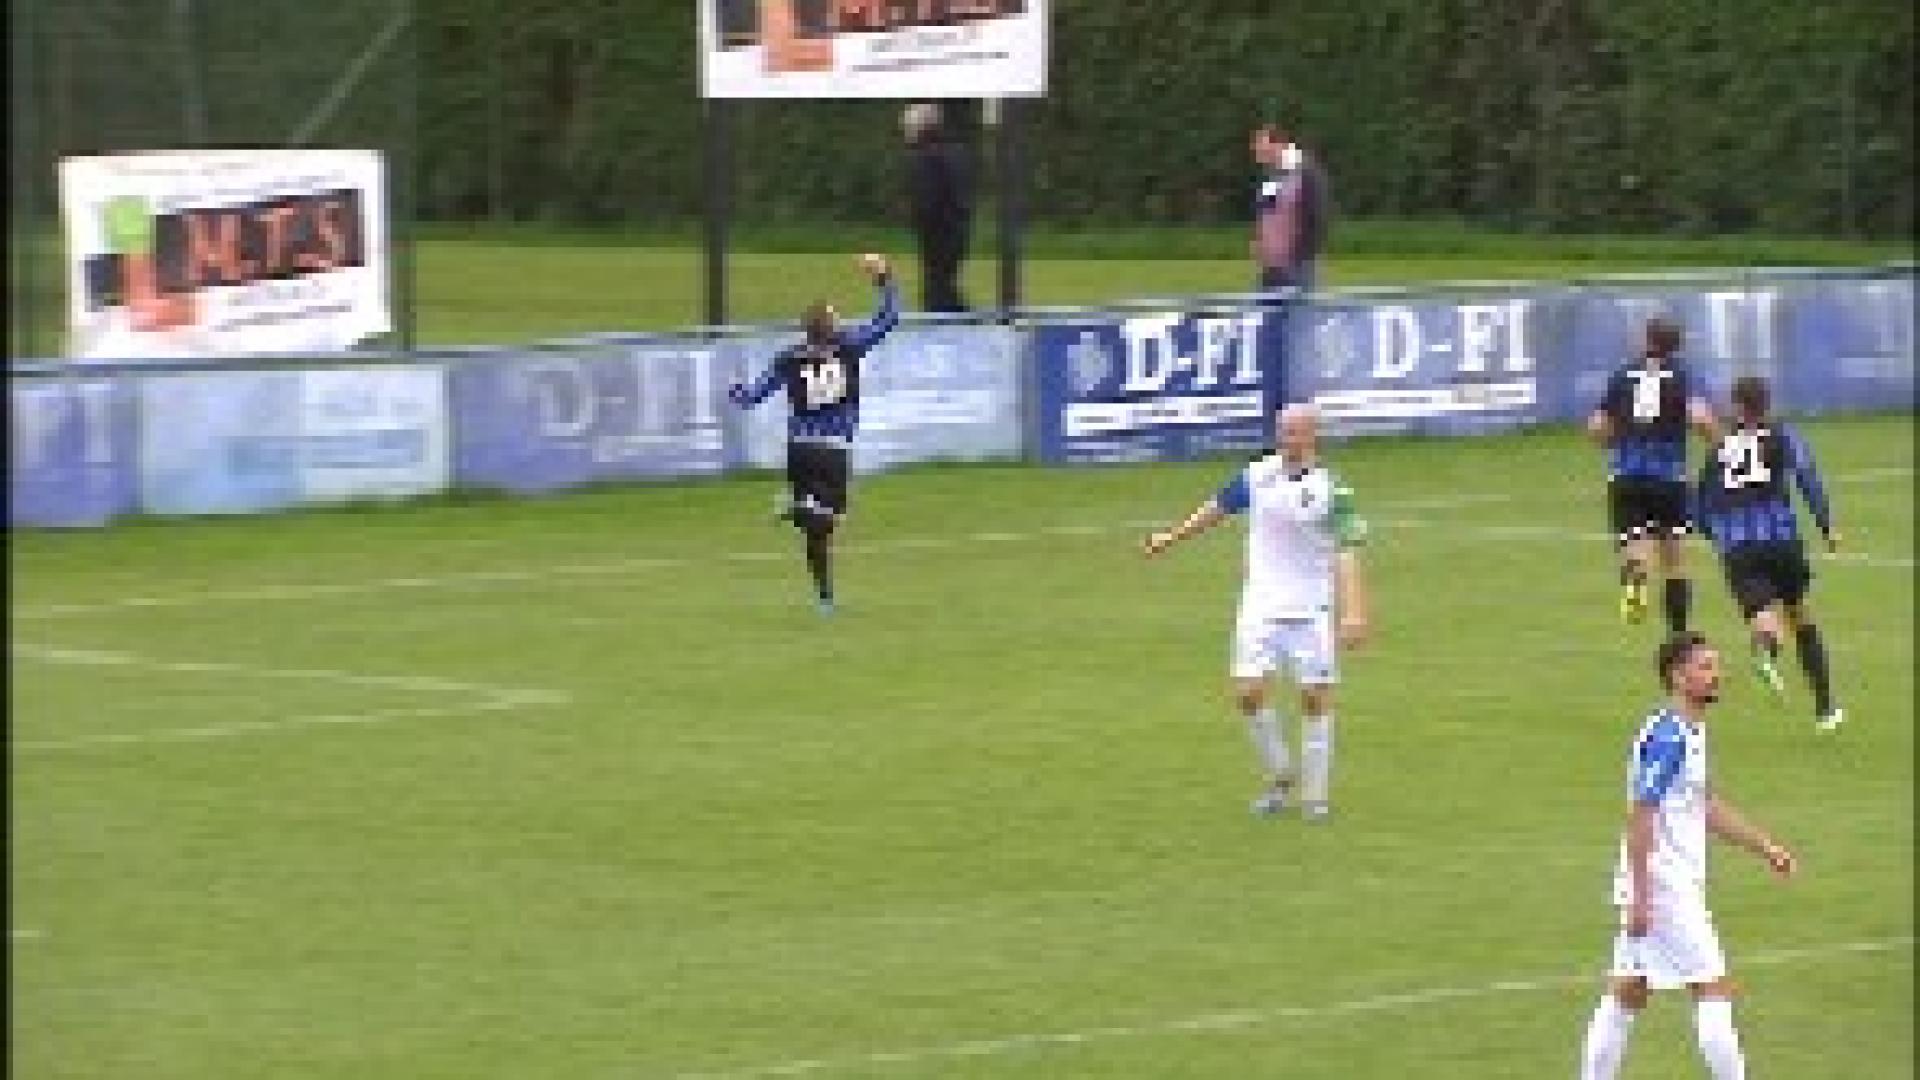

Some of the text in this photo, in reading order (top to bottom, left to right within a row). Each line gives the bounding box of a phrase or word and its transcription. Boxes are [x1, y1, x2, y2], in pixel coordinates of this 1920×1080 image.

[1124, 312, 1264, 391] D-FI
[1372, 299, 1535, 378] D-FI
[1717, 430, 1772, 489] 21
